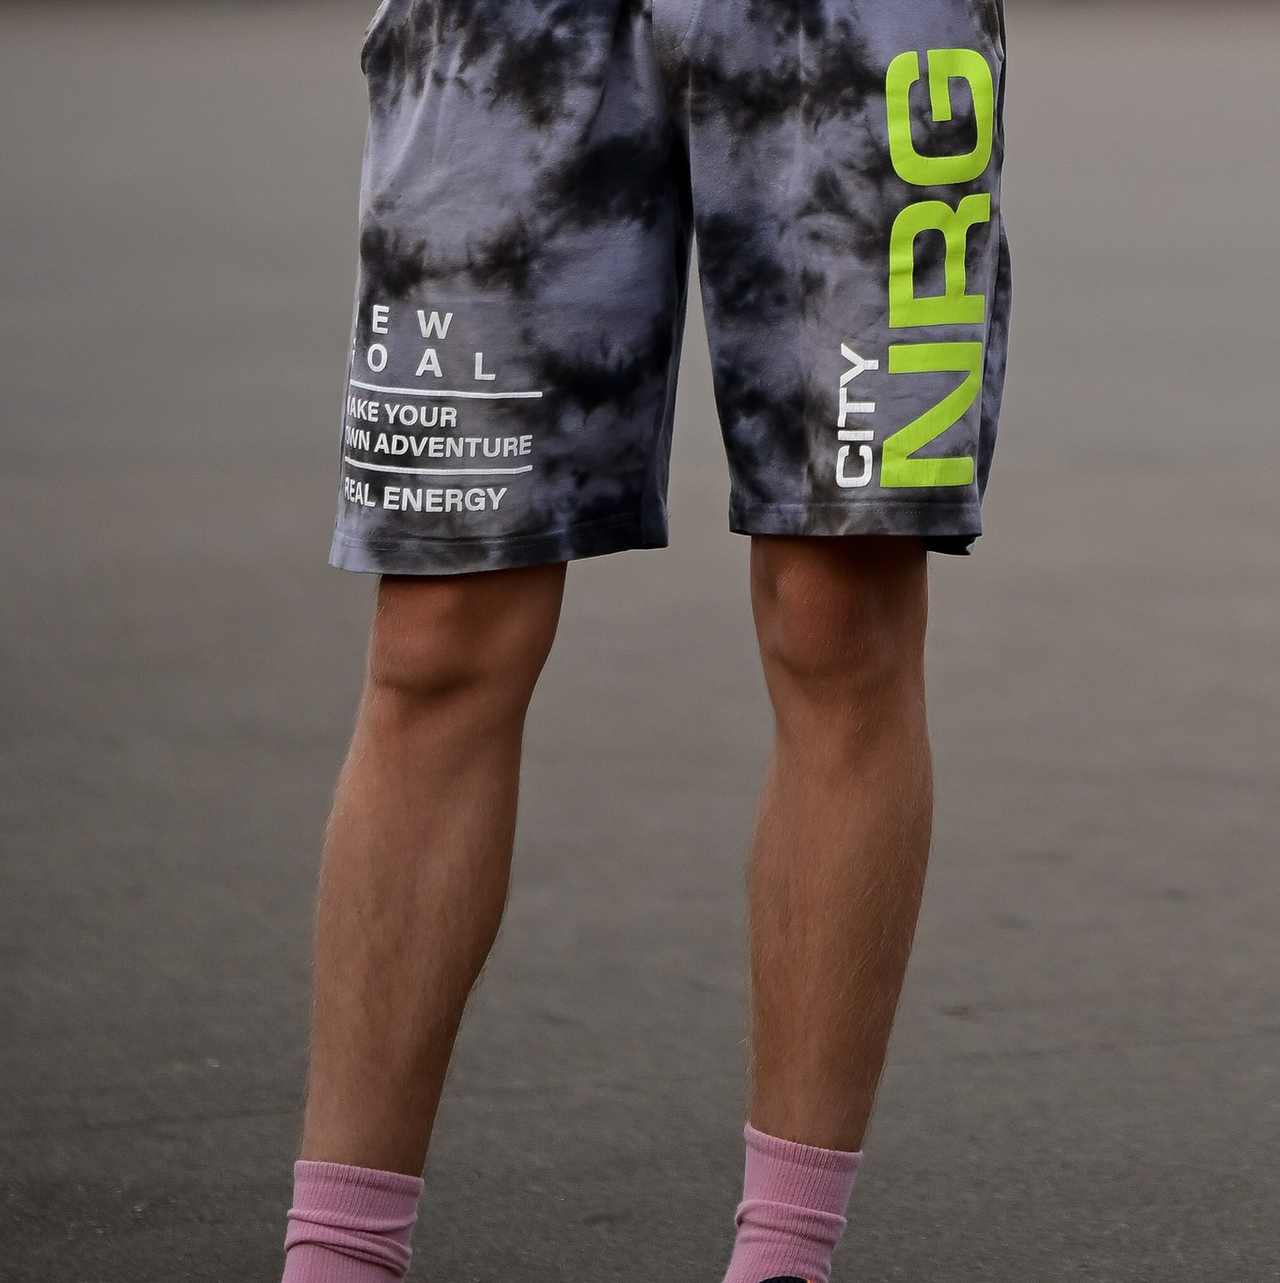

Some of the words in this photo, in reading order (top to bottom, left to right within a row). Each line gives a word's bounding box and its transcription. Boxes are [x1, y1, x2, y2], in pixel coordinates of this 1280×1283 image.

[880, 47, 993, 488] NRG
[385, 404, 457, 428] YOUR
[835, 342, 879, 488] CITY
[374, 433, 533, 458] ADVENTURE
[383, 486, 508, 513] ENERGY
